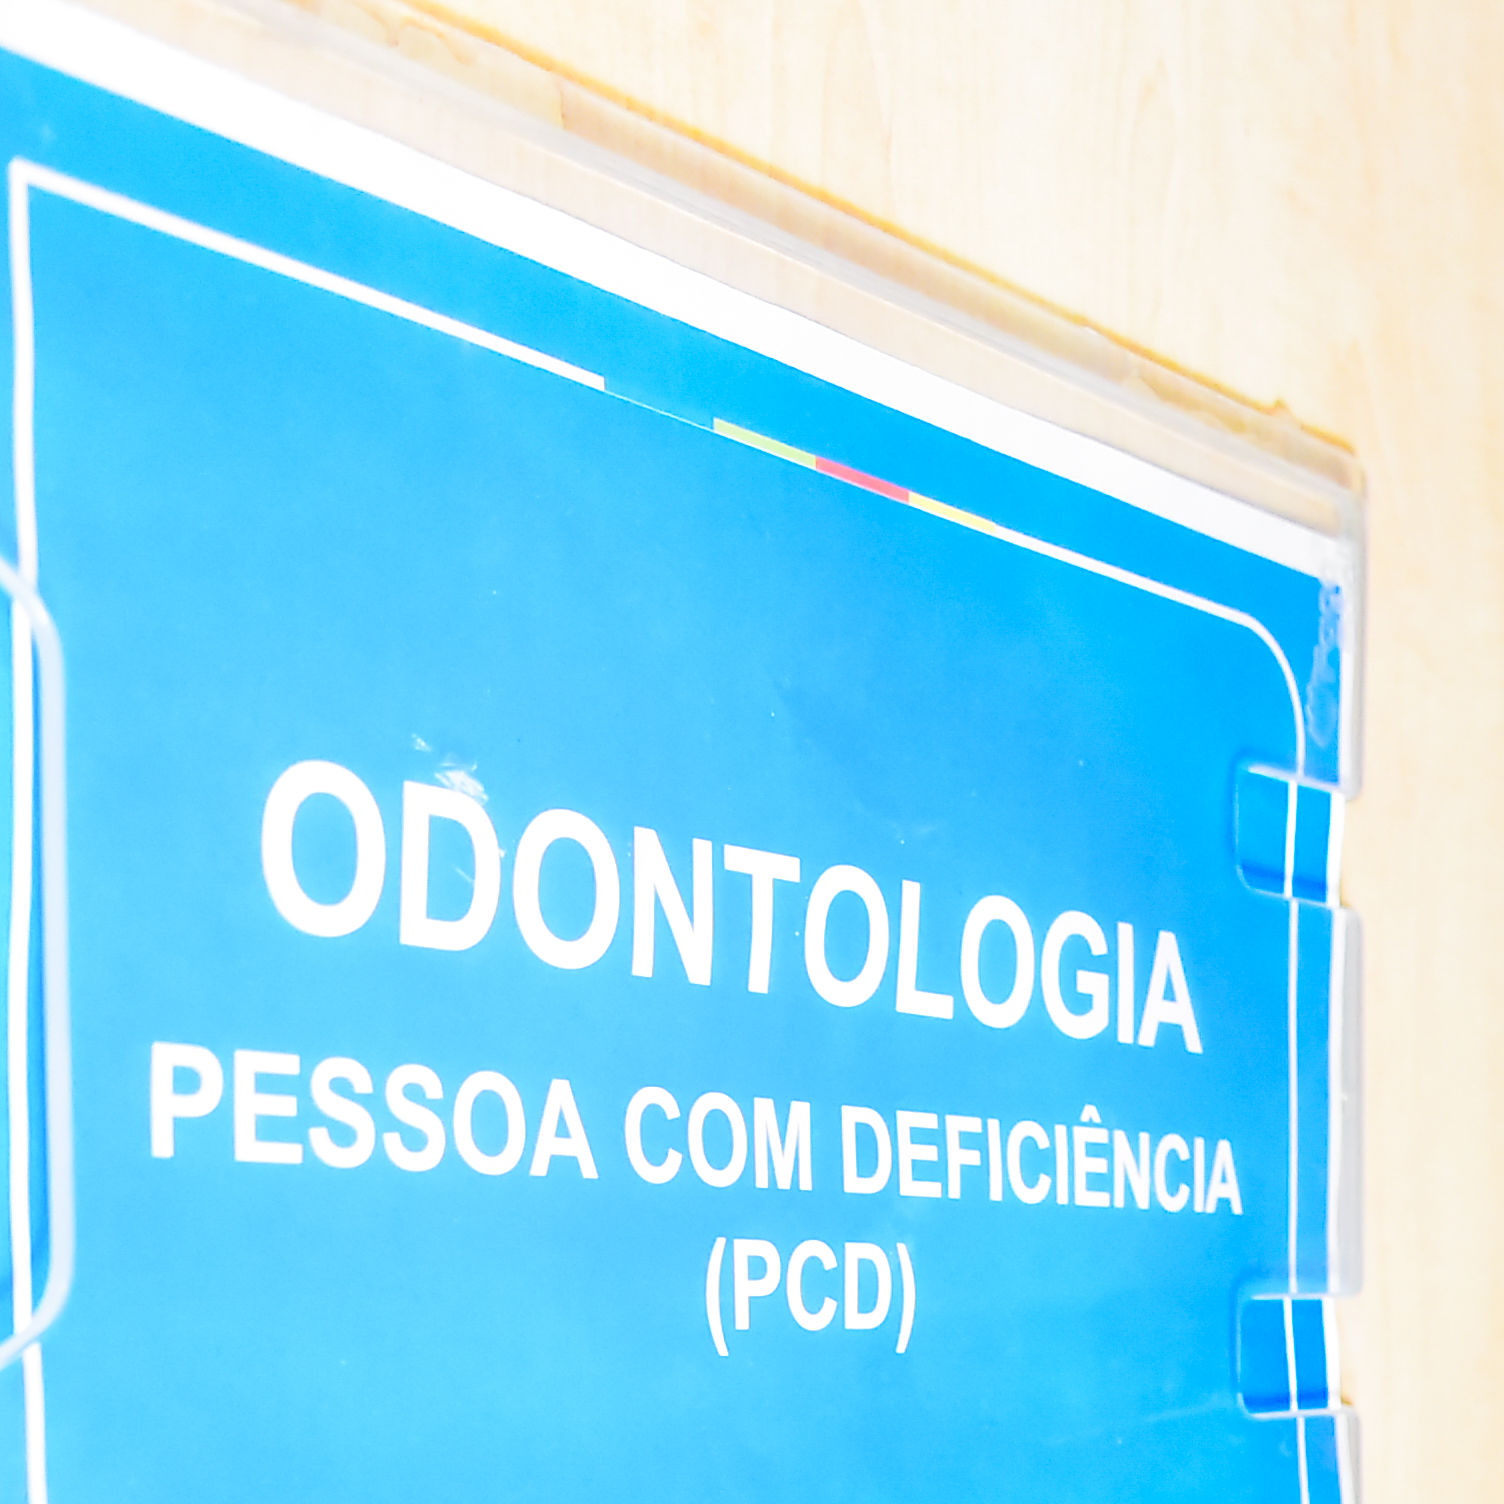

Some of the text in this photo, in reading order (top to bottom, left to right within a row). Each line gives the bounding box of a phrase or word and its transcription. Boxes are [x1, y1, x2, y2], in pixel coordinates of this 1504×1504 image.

[261, 759, 1203, 1054] ODONTOLOGIA
[150, 1040, 1243, 1215] PESSOA COM DEFICIÊNCIA
[705, 1236, 916, 1357] (PCD)
